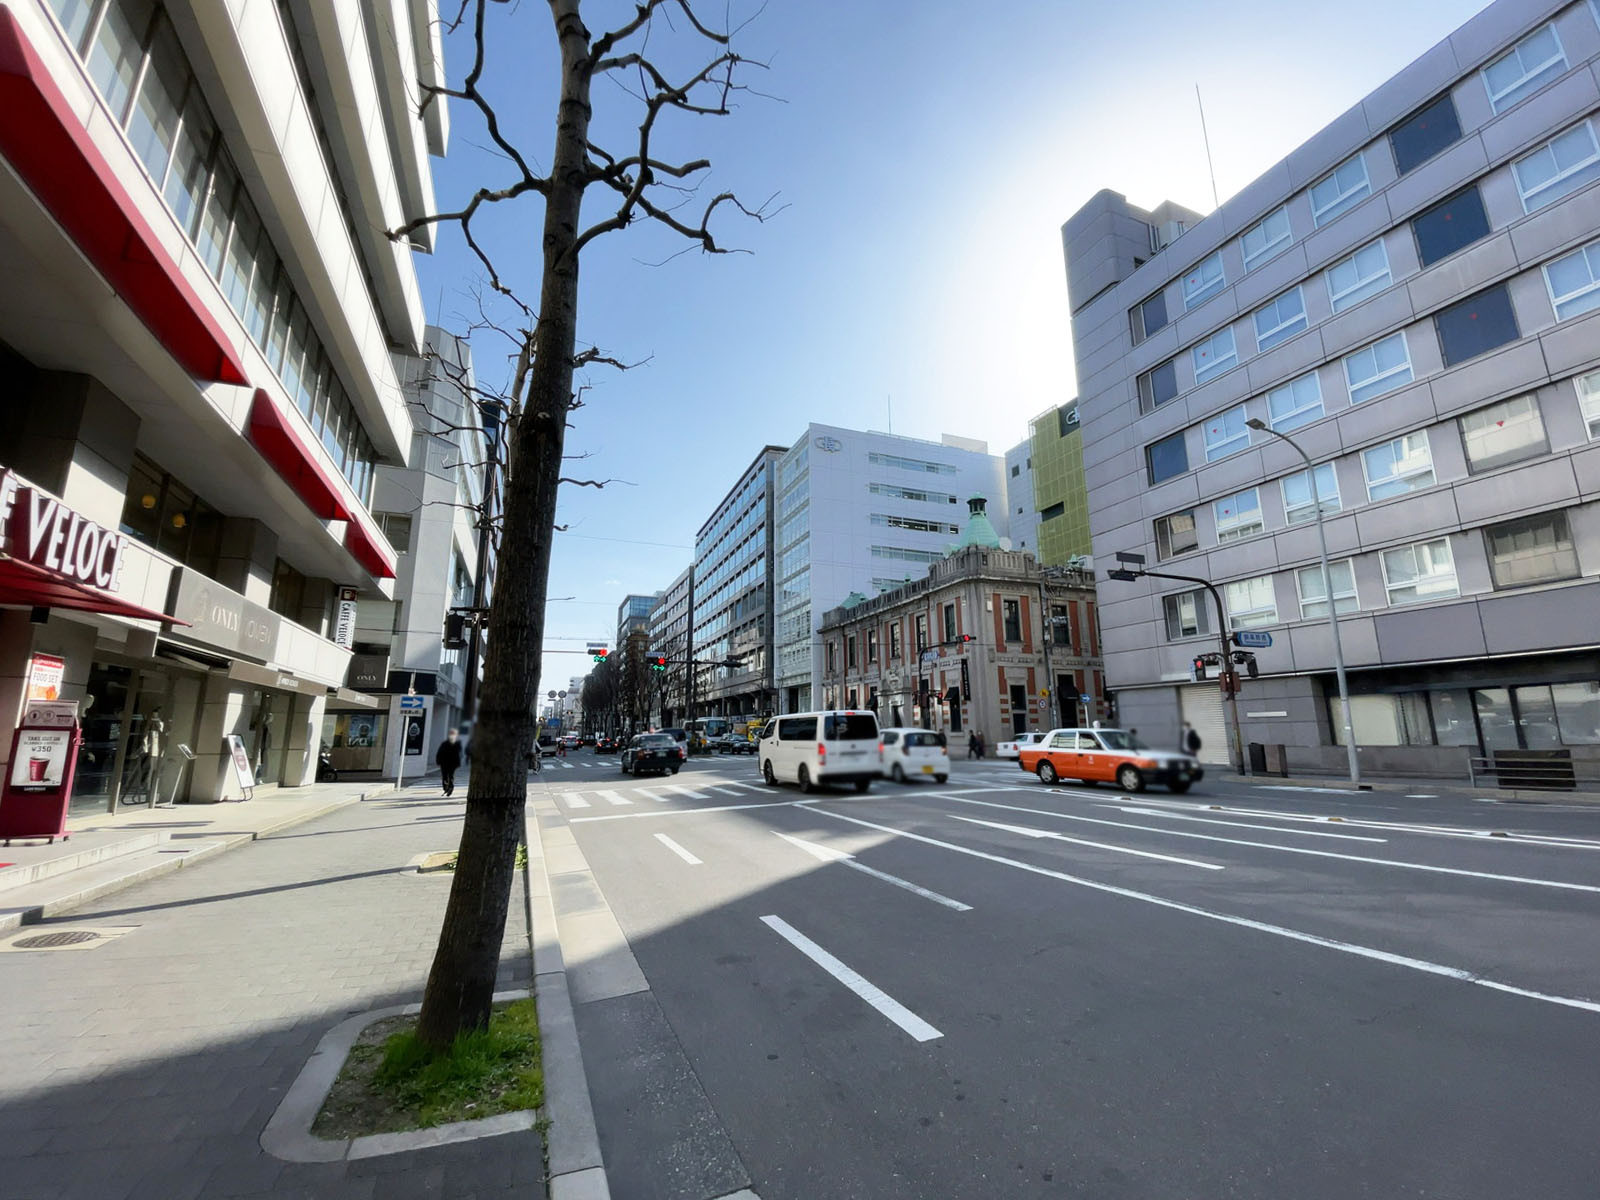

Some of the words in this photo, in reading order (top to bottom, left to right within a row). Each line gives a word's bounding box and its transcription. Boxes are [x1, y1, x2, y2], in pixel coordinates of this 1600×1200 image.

[29, 487, 129, 592] VELOCE
[340, 602, 351, 621] CAFFE
[337, 623, 348, 645] VELOCE
[33, 672, 48, 682] FOOD
[48, 674, 59, 683] SET
